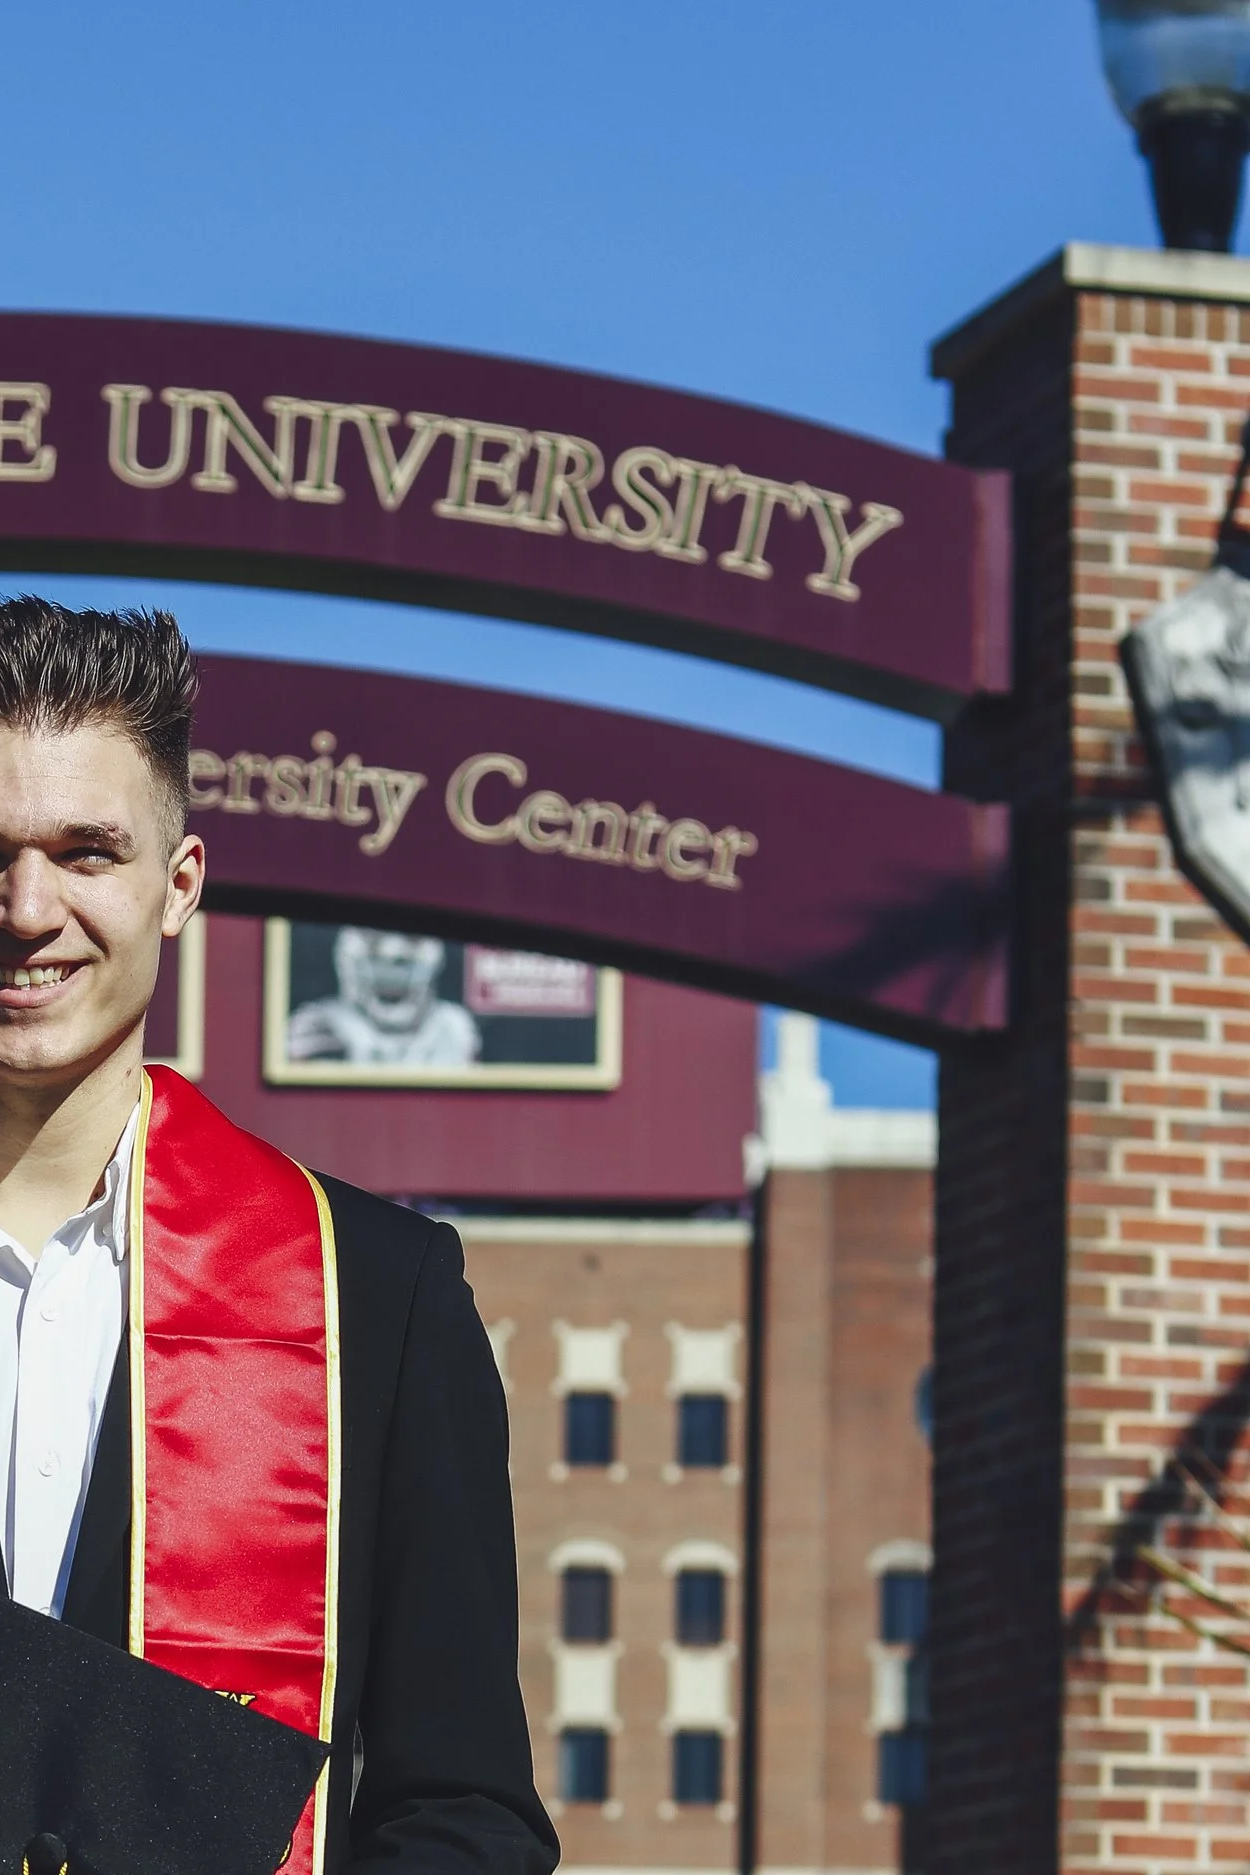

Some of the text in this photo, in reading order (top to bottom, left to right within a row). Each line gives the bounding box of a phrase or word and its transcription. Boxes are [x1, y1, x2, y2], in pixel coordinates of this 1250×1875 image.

[101, 384, 904, 602] UNIVERSITY
[189, 730, 428, 856] ersity
[445, 752, 758, 891] Center
